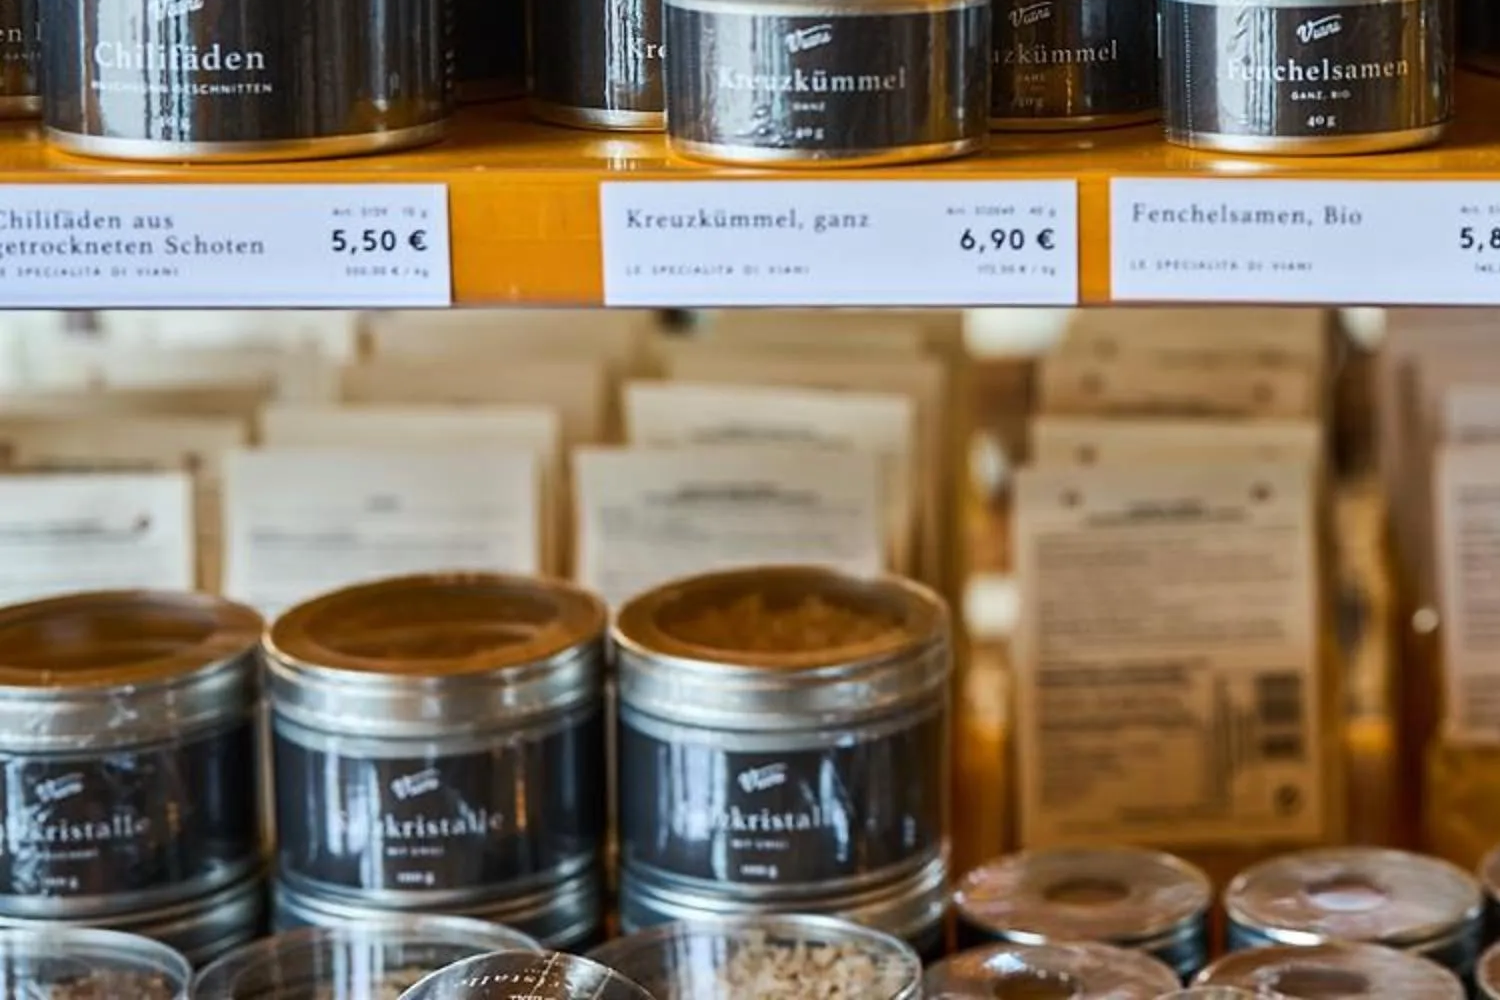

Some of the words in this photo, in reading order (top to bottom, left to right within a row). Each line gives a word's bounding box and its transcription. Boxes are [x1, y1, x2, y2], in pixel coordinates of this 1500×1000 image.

[94, 42, 266, 71] Chilifäden
[133, 214, 175, 230] aus
[625, 207, 804, 230] Kreuzkümmel,
[812, 211, 870, 233] ganz
[1132, 202, 1314, 227] Fenchelsamen,
[1323, 204, 1363, 226] Bio
[164, 233, 265, 256] Schoten
[331, 228, 397, 256] 5,50
[408, 228, 429, 252] €
[959, 227, 1025, 254] 6,90
[1036, 227, 1056, 251] €
